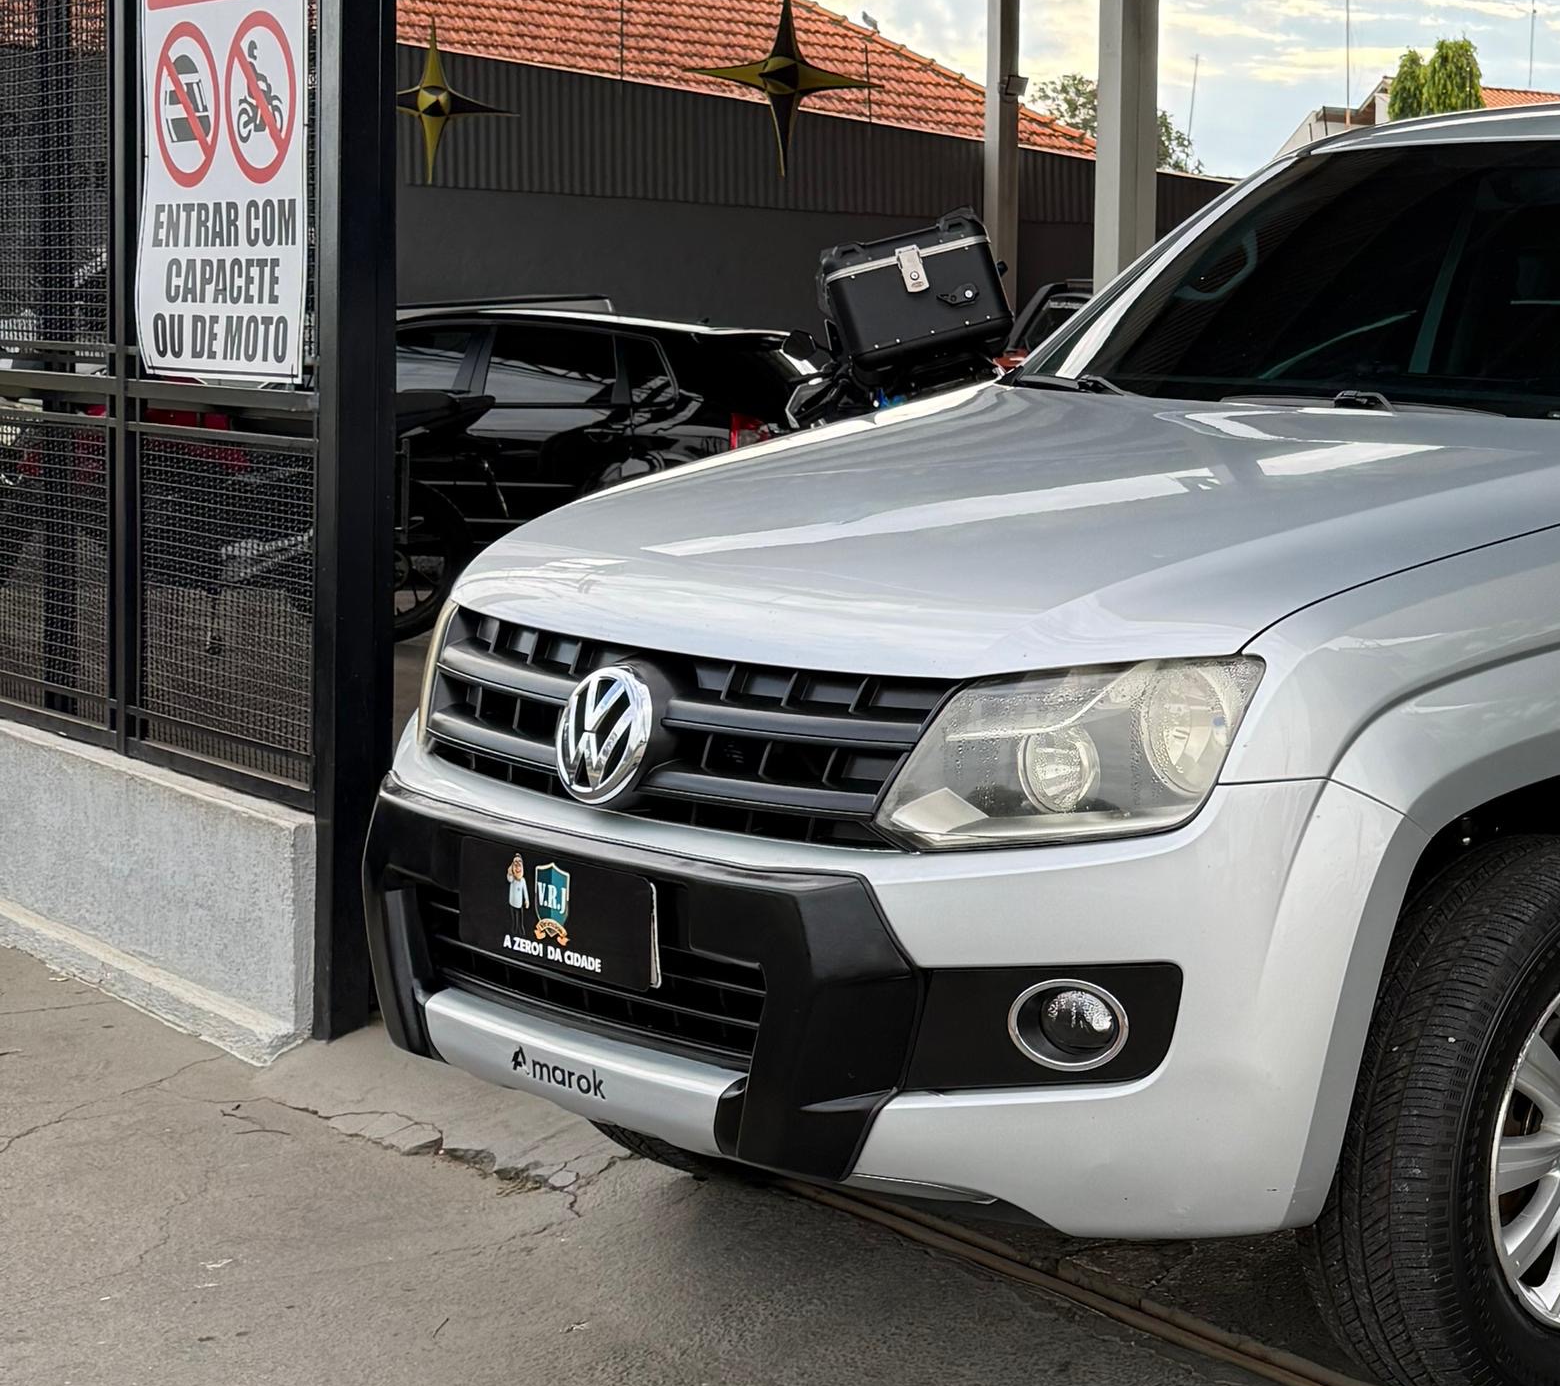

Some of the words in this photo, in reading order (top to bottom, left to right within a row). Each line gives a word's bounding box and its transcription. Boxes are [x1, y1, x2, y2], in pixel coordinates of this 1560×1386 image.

[152, 201, 240, 248] ENTRAR
[245, 198, 297, 248] COM
[165, 257, 280, 305] CAPACETE
[153, 312, 184, 359] OU
[191, 314, 220, 360] DE
[222, 314, 289, 364] MOTO
[537, 881, 567, 915] V.R.J
[503, 934, 512, 949] A
[546, 945, 563, 963] DA
[563, 950, 602, 973] CIDADE
